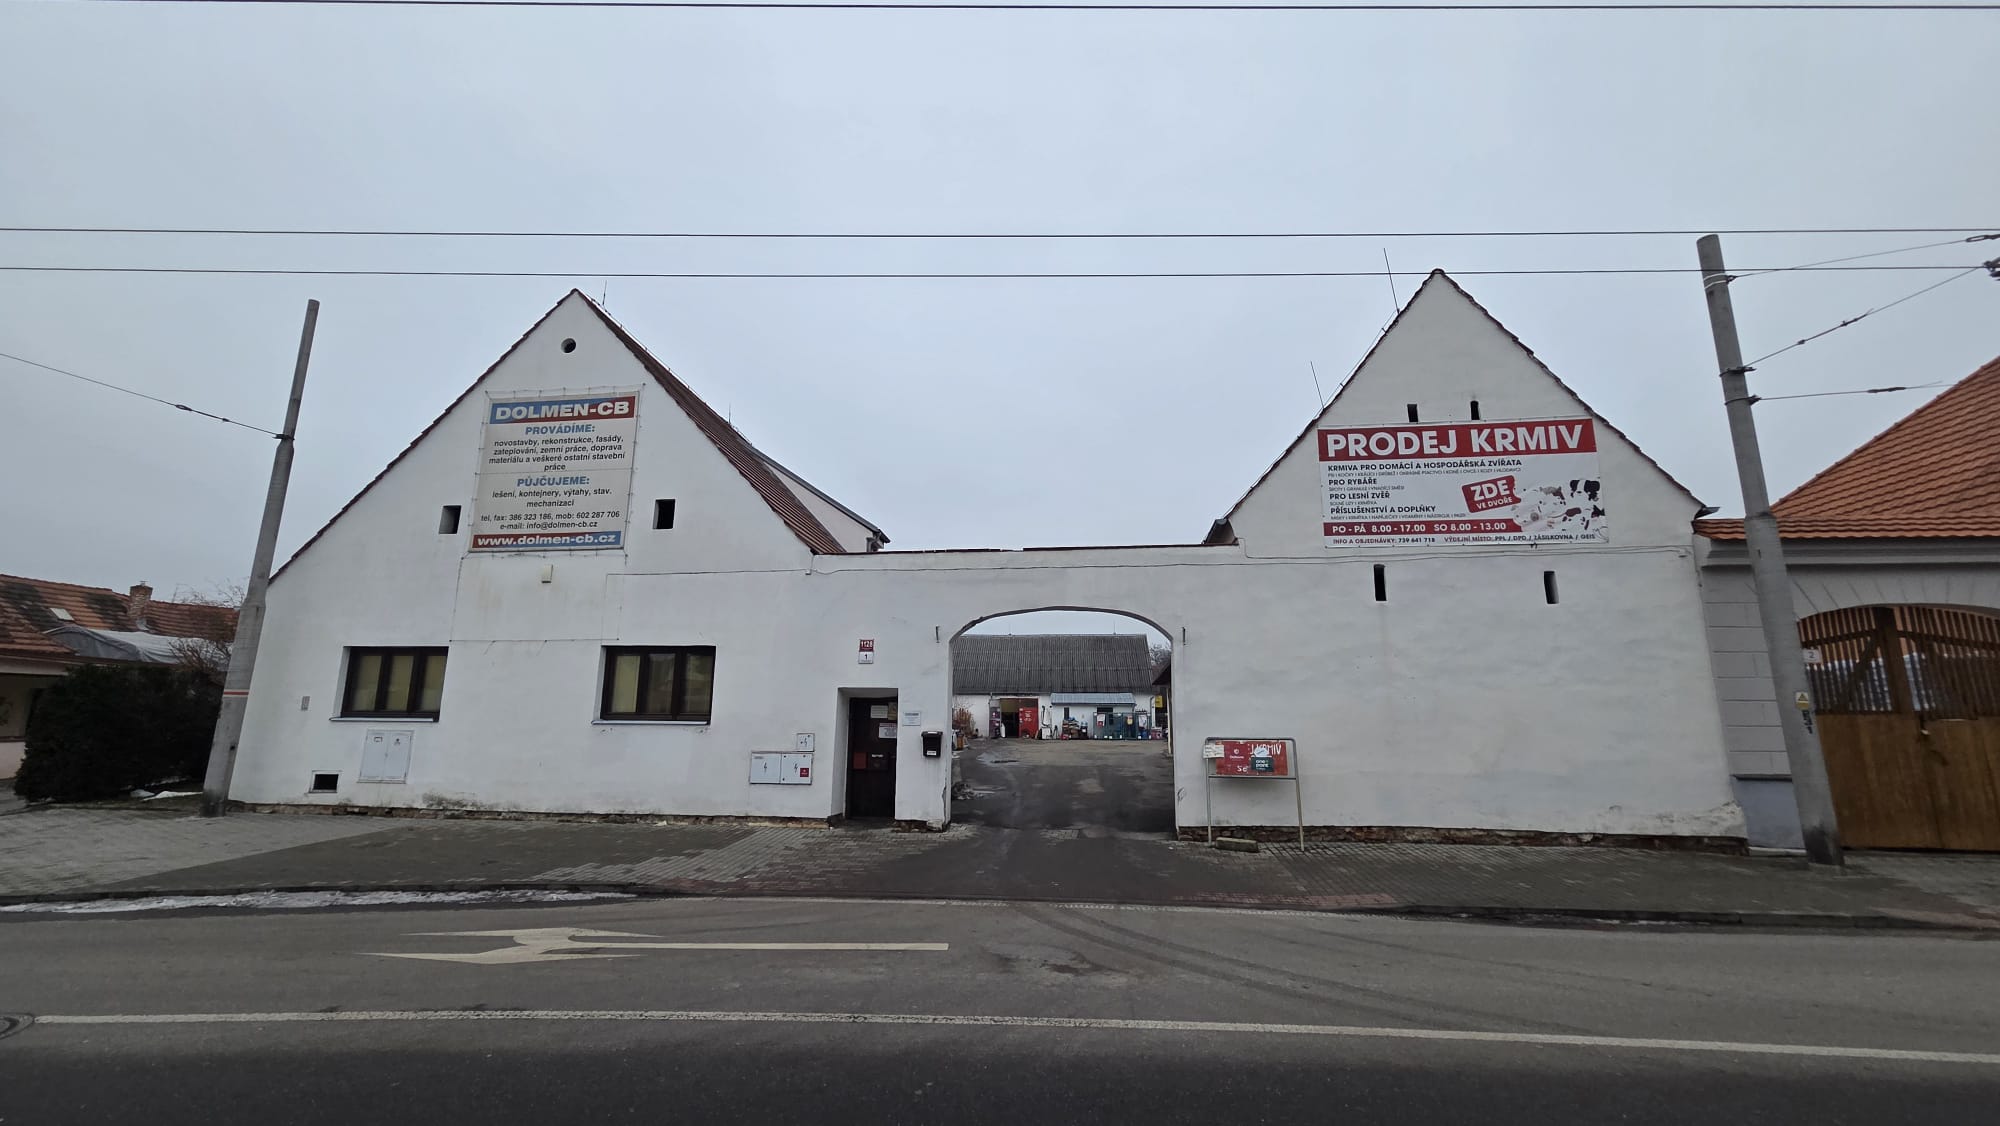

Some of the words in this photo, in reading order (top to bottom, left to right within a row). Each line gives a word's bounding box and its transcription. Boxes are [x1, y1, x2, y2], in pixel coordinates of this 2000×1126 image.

[495, 401, 630, 420] DOLMEN-CB
[525, 423, 596, 435] PROVÁDÍME:
[494, 439, 539, 447] novostavby,
[541, 437, 594, 445] rekonstrukce,
[596, 435, 624, 443] fasády,
[1327, 429, 1457, 457] PRODEJ
[1470, 424, 1583, 453] KRMIV
[540, 445, 564, 454] zemní
[565, 445, 589, 454] práce,
[590, 444, 622, 452] doprava
[488, 456, 524, 464] materiálu
[532, 454, 562, 462] veškeré
[564, 453, 591, 461] ostatní
[592, 452, 626, 460] stavební
[544, 463, 566, 472] práce
[1328, 464, 1358, 472] KRMIVA
[1379, 462, 1414, 470] DOMÁCÍ
[1424, 459, 1486, 469] HOSPODÁŘSKÁ
[1488, 458, 1522, 467] ZVÍŘATA
[517, 475, 590, 487] PŮJČUJEME:
[1348, 477, 1377, 485] RYBÁŘE
[492, 490, 517, 498] lešení,
[518, 489, 561, 498] kontejnery,
[563, 488, 591, 497] výtahy,
[1371, 491, 1390, 499] ZVĚŘ
[1471, 480, 1511, 501] ZDE
[1488, 496, 1513, 507] DVOŘE
[1331, 504, 1388, 514] PŘÍSLUŠENSTVÍ
[1398, 505, 1436, 513] DOPLŇKY
[526, 521, 598, 530] info@dolmen-cb.cz
[1332, 525, 1346, 533] PO
[1354, 523, 1366, 533] PÁ
[1371, 525, 1392, 533] 8.00
[1399, 524, 1426, 532] 17.00
[1450, 523, 1471, 531] 8.00
[1480, 522, 1507, 530] 13.00
[477, 533, 616, 546] www.dolmen-cb.cz
